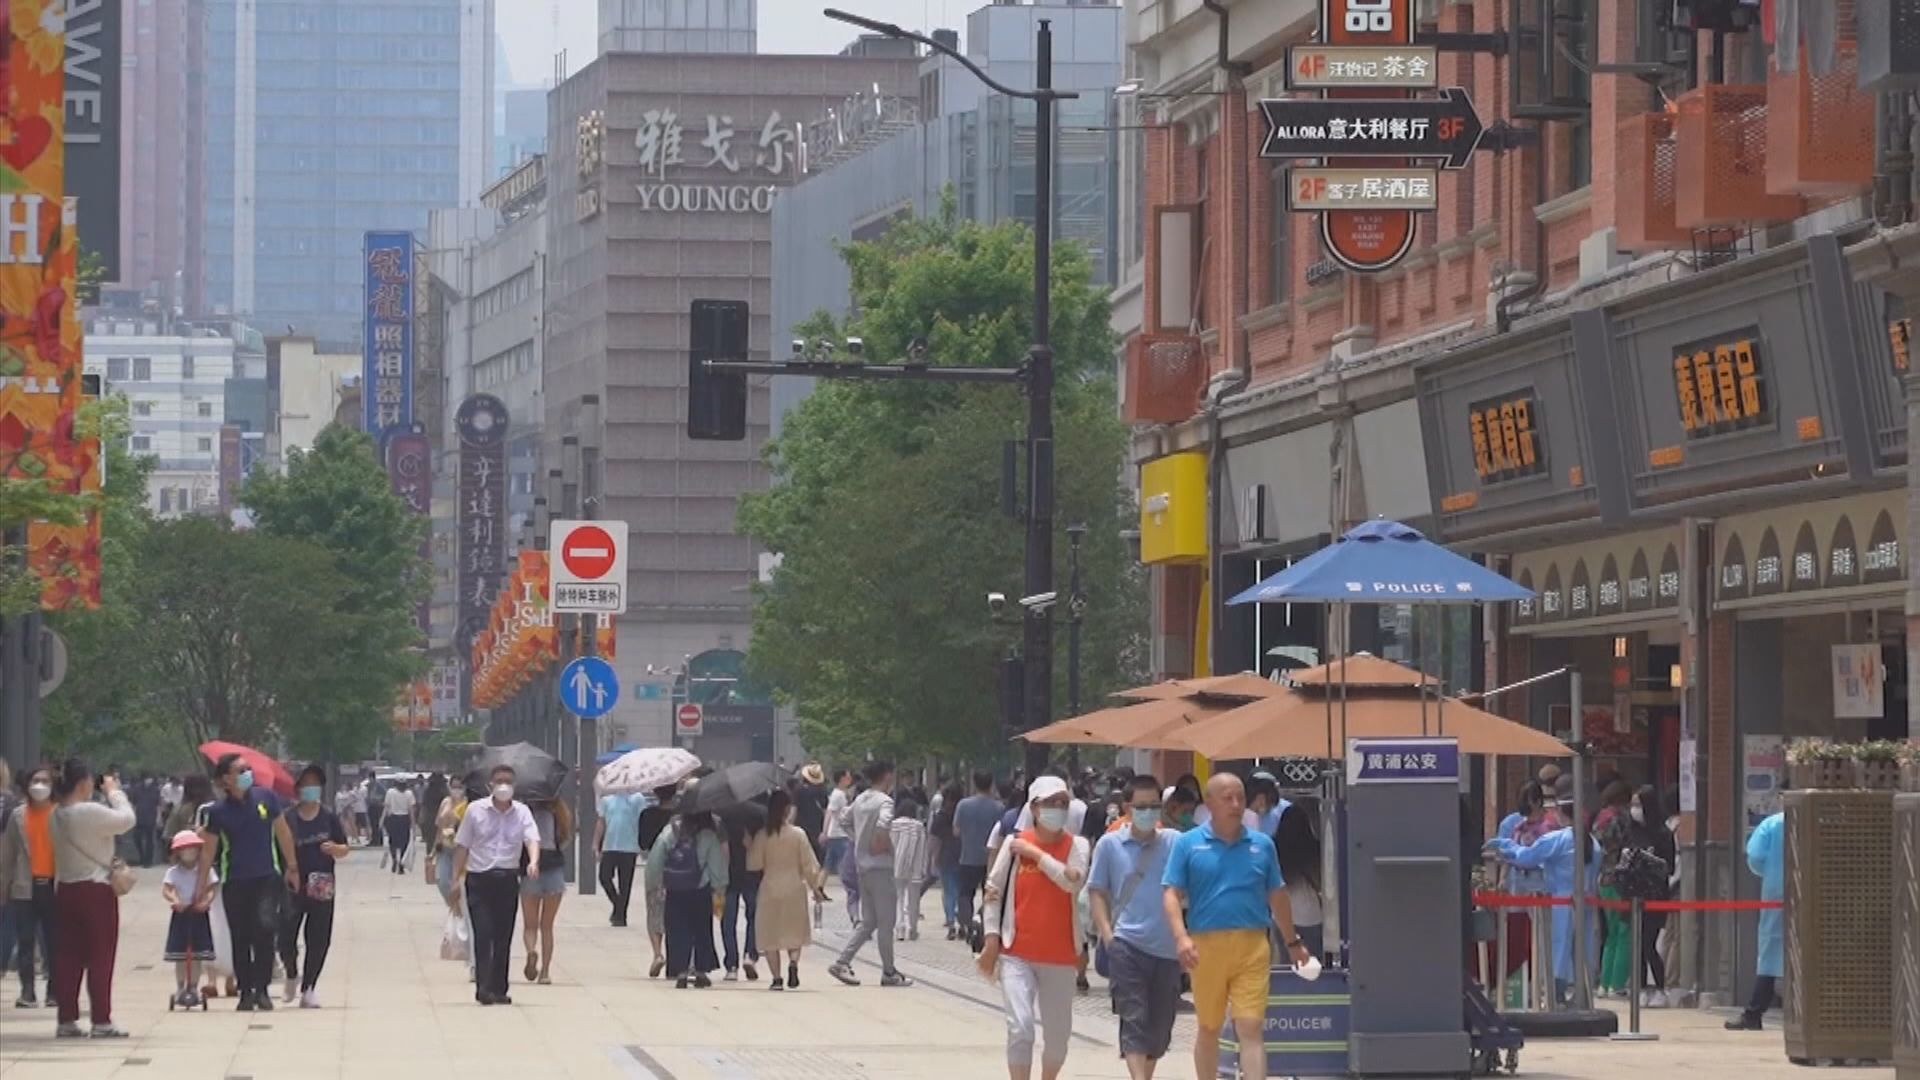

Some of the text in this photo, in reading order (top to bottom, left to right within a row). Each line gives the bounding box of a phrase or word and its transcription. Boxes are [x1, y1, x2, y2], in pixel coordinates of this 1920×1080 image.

[1299, 55, 1325, 78] 4F
[1383, 55, 1429, 77] 茶舍
[1277, 117, 1465, 140] ALLORA 意大利餐厅 3F
[635, 107, 795, 181] 雅戈尔
[1299, 177, 1327, 200] 2F
[1372, 581, 1446, 593] POLICE
[1367, 753, 1437, 770] 黄浦公安
